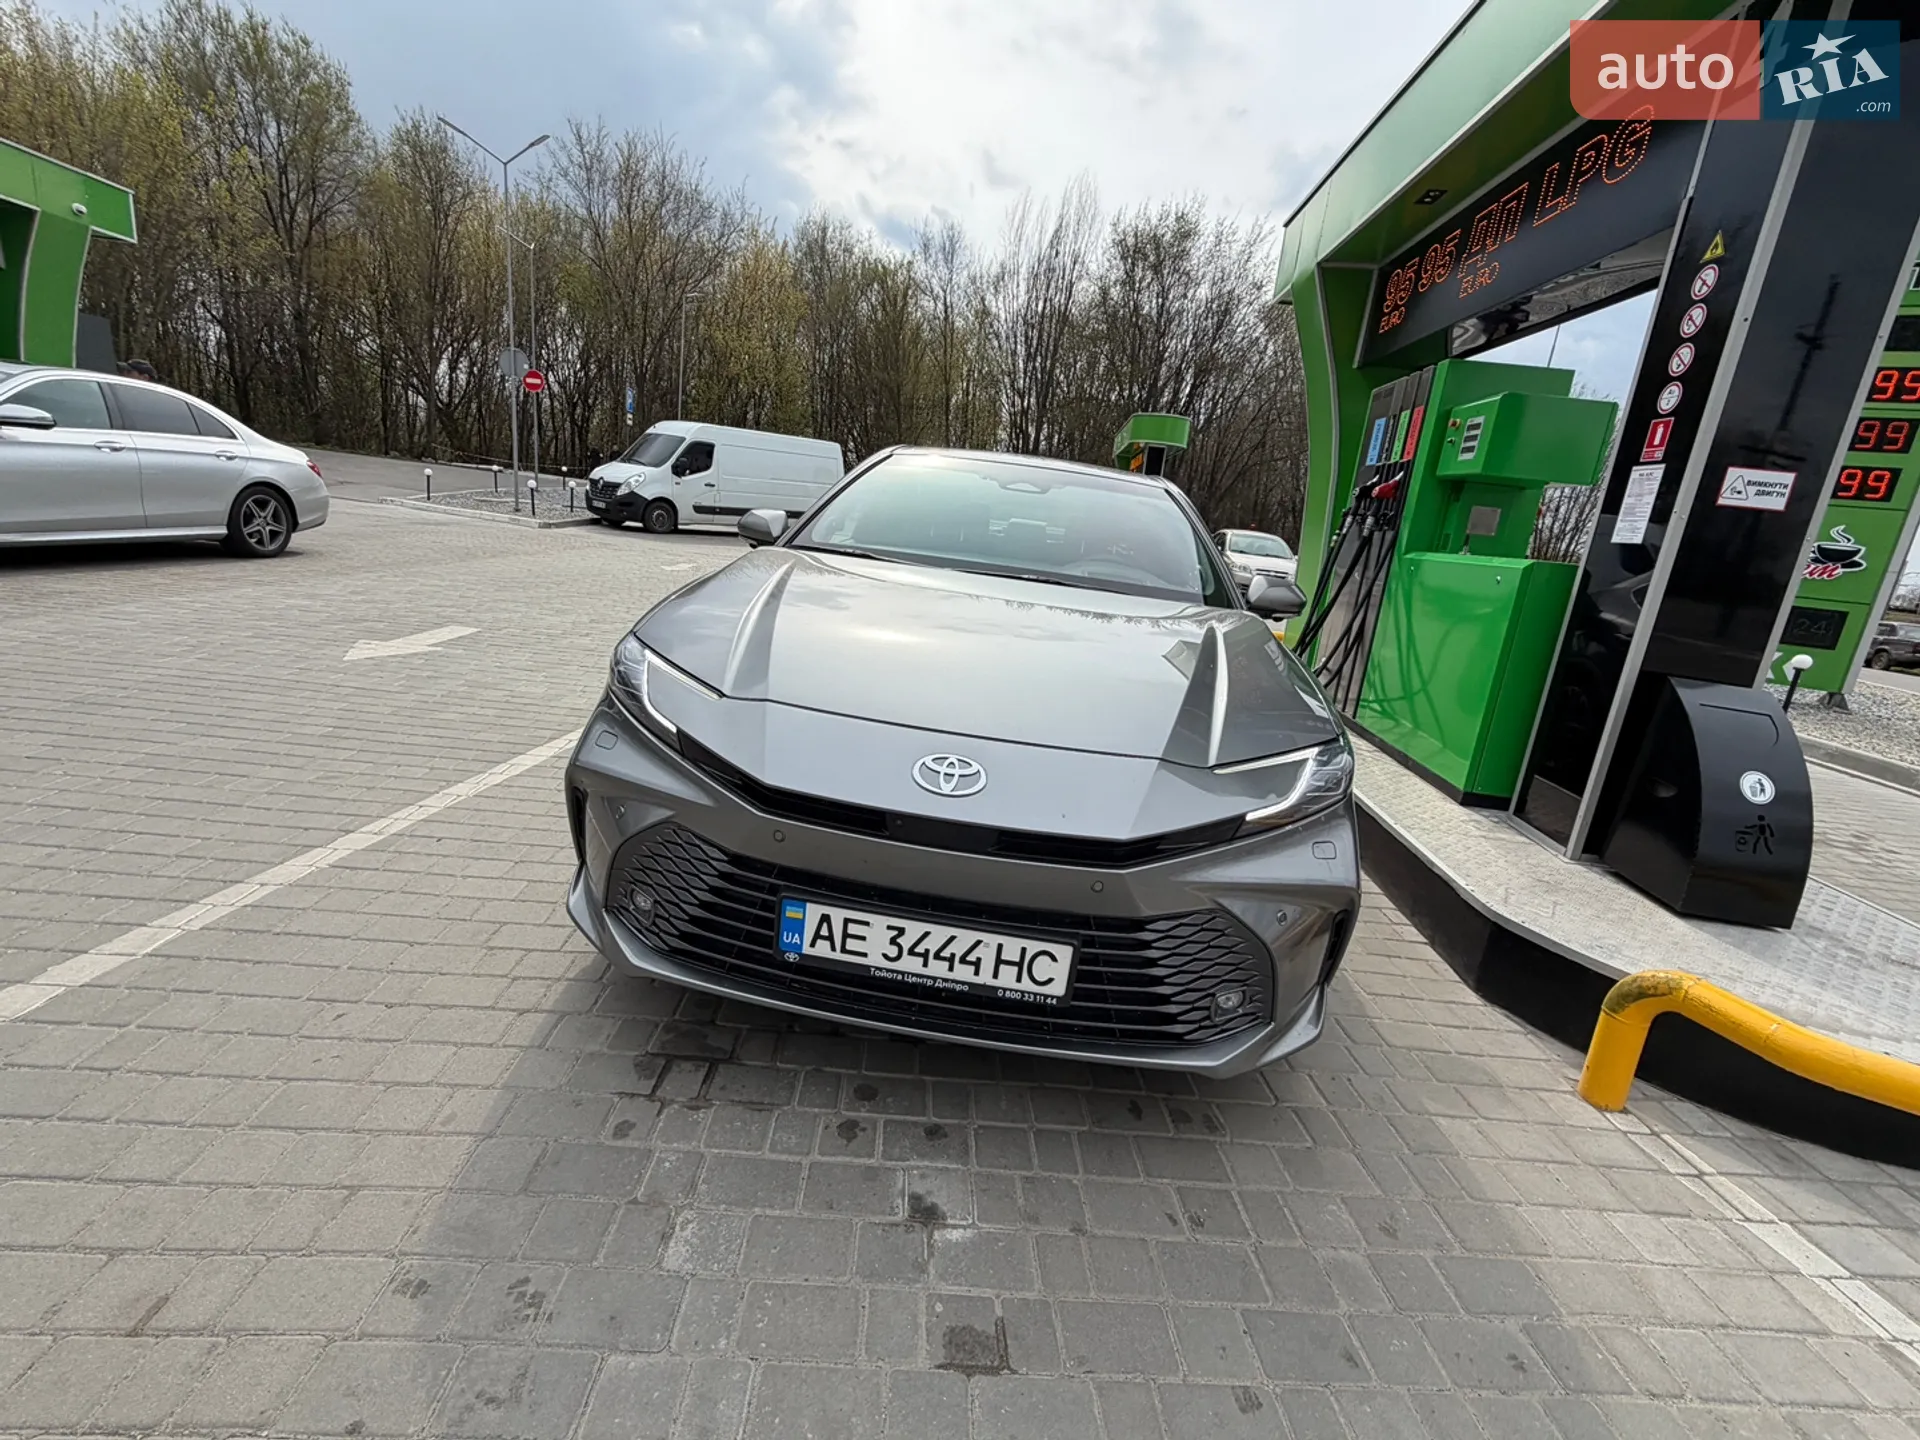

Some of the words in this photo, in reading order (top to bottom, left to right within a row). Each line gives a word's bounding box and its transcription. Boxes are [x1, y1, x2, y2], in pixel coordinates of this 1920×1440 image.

[1383, 257, 1420, 313] 95
[1418, 228, 1461, 292] 95
[1533, 104, 1654, 227] LPG
[1379, 306, 1406, 334] EURO
[1458, 262, 1500, 299] EURO
[1855, 420, 1910, 450] 99
[1746, 479, 1789, 490] ВИМКНУТИ
[1753, 489, 1786, 499] ДВИГУН
[1837, 468, 1892, 499] 99
[783, 931, 801, 945] UA
[809, 913, 871, 959] AE
[881, 923, 984, 977] 3444
[992, 942, 1059, 987] HC
[869, 967, 902, 981] Тойота
[903, 974, 934, 987] Центр
[934, 978, 969, 992] Дніпро
[997, 988, 1003, 997] 0
[1005, 990, 1022, 1001] 800
[1023, 993, 1035, 1002] 33
[1036, 994, 1045, 1004] 11
[1045, 996, 1057, 1006] 44
